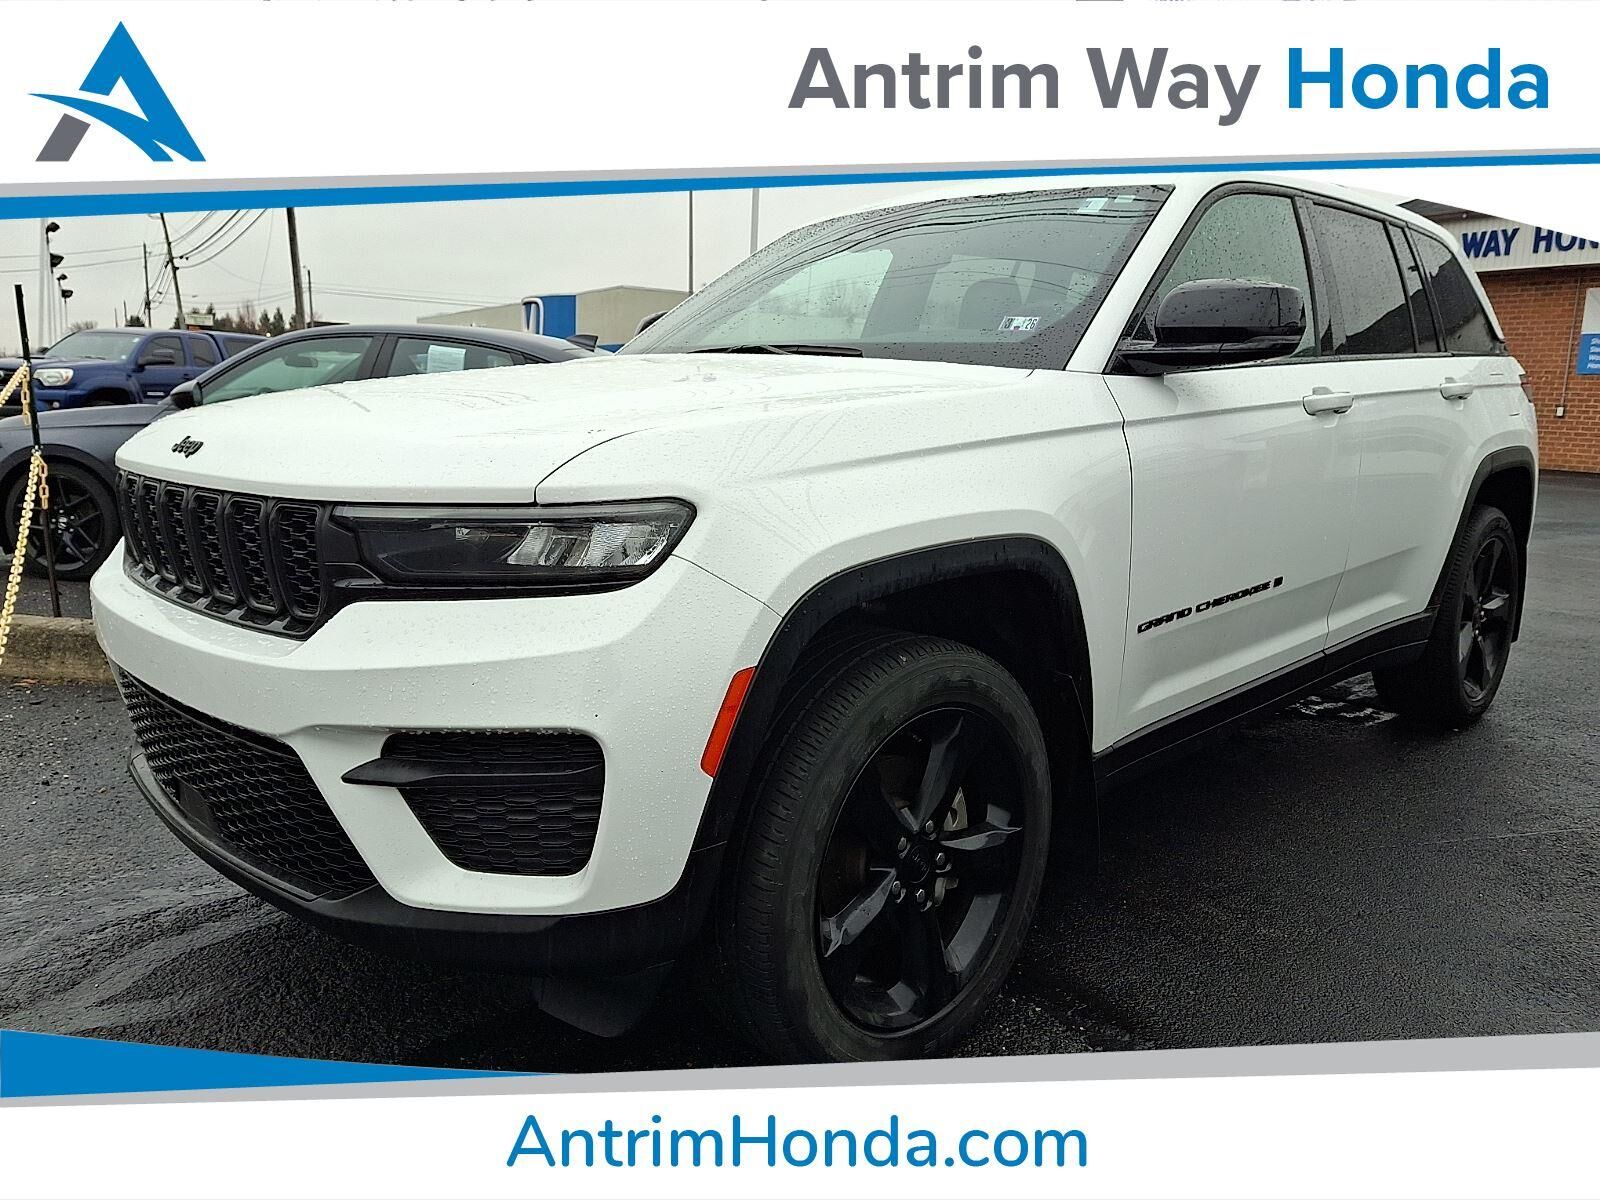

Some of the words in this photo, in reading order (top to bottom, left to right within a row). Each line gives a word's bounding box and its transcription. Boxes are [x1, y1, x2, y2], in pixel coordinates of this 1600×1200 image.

[1462, 227, 1520, 259] WAY
[171, 435, 204, 459] Jeep
[1137, 606, 1193, 634] GRAND
[1195, 580, 1272, 613] CHEROKEE
